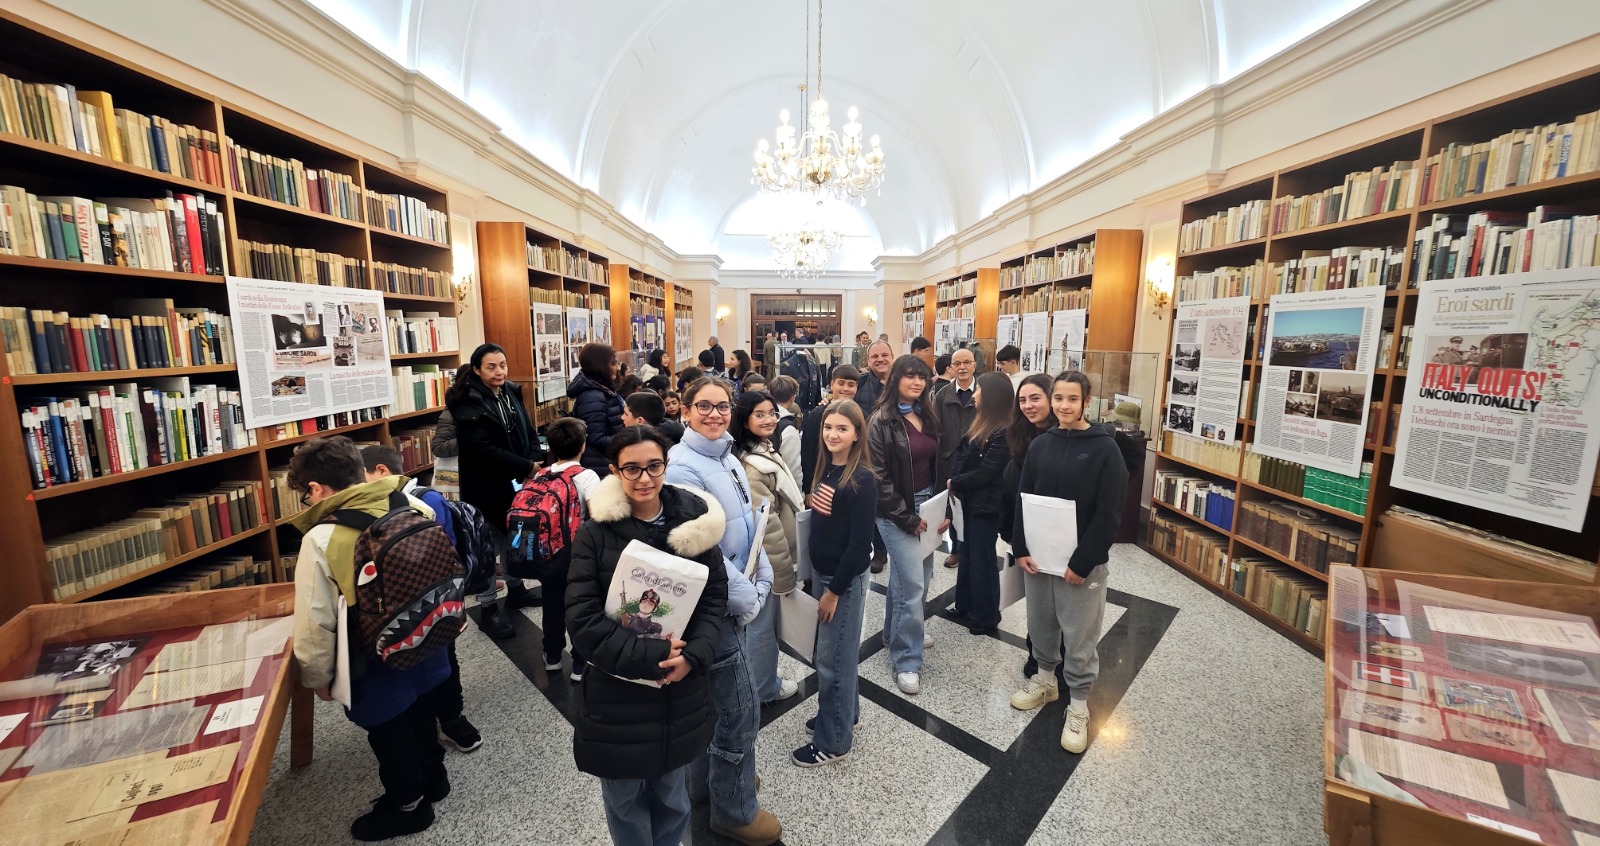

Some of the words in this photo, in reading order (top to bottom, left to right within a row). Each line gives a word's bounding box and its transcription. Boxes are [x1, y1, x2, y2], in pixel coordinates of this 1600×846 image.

[1436, 295, 1469, 313] Eroi
[1470, 292, 1515, 312] sardi
[1421, 363, 1472, 392] ITALY
[1477, 368, 1548, 401] QUITS!
[1419, 387, 1541, 413] UNCONDITIONALLY
[1415, 415, 1446, 427] tedeschi
[1446, 422, 1460, 430] ora
[1460, 423, 1480, 432] sono
[1486, 425, 1518, 438] nemici
[1425, 406, 1462, 420] settembre
[1463, 410, 1471, 419] in
[1474, 412, 1514, 426] Sardegna
[630, 566, 688, 598] 2026
